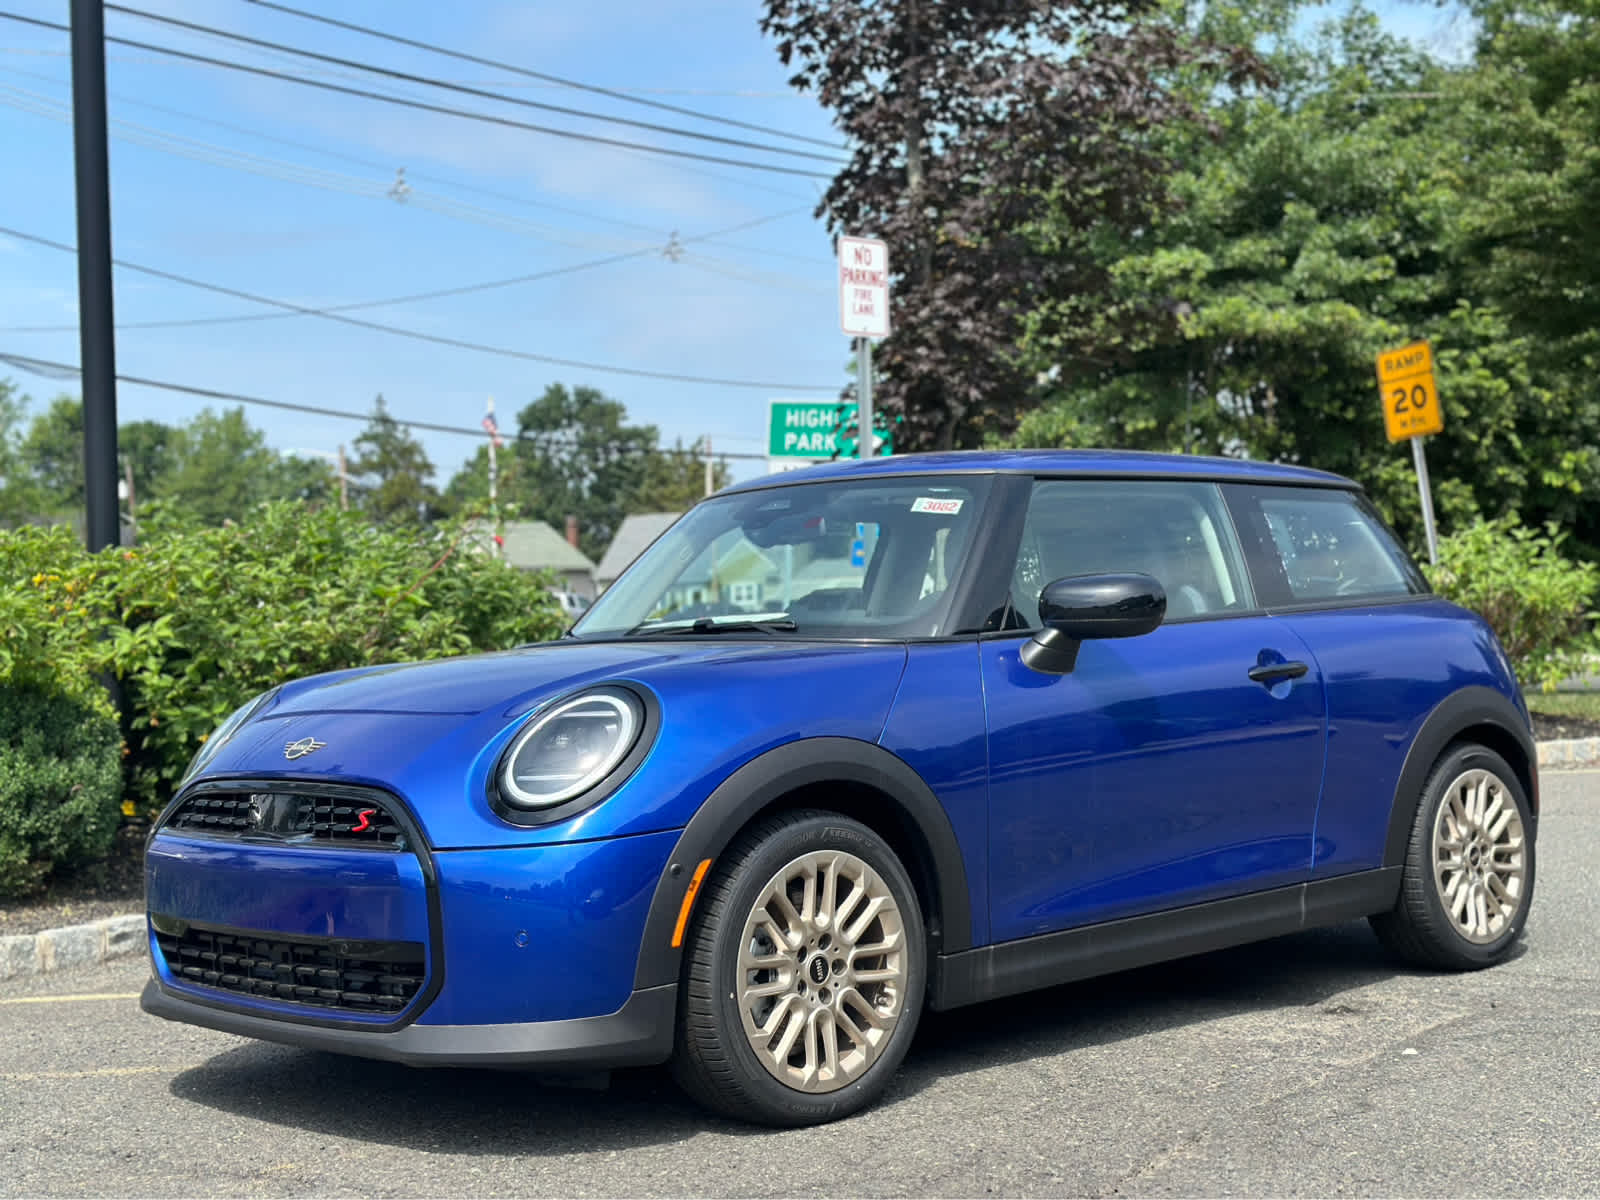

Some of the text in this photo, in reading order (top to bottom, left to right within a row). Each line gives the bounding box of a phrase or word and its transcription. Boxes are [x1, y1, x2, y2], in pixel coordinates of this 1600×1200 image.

[854, 247, 872, 266] NO
[841, 267, 887, 288] PARKING
[1383, 350, 1425, 373] RAMP
[1393, 384, 1427, 414] 20
[784, 431, 838, 451] PARK
[351, 809, 377, 832] S
